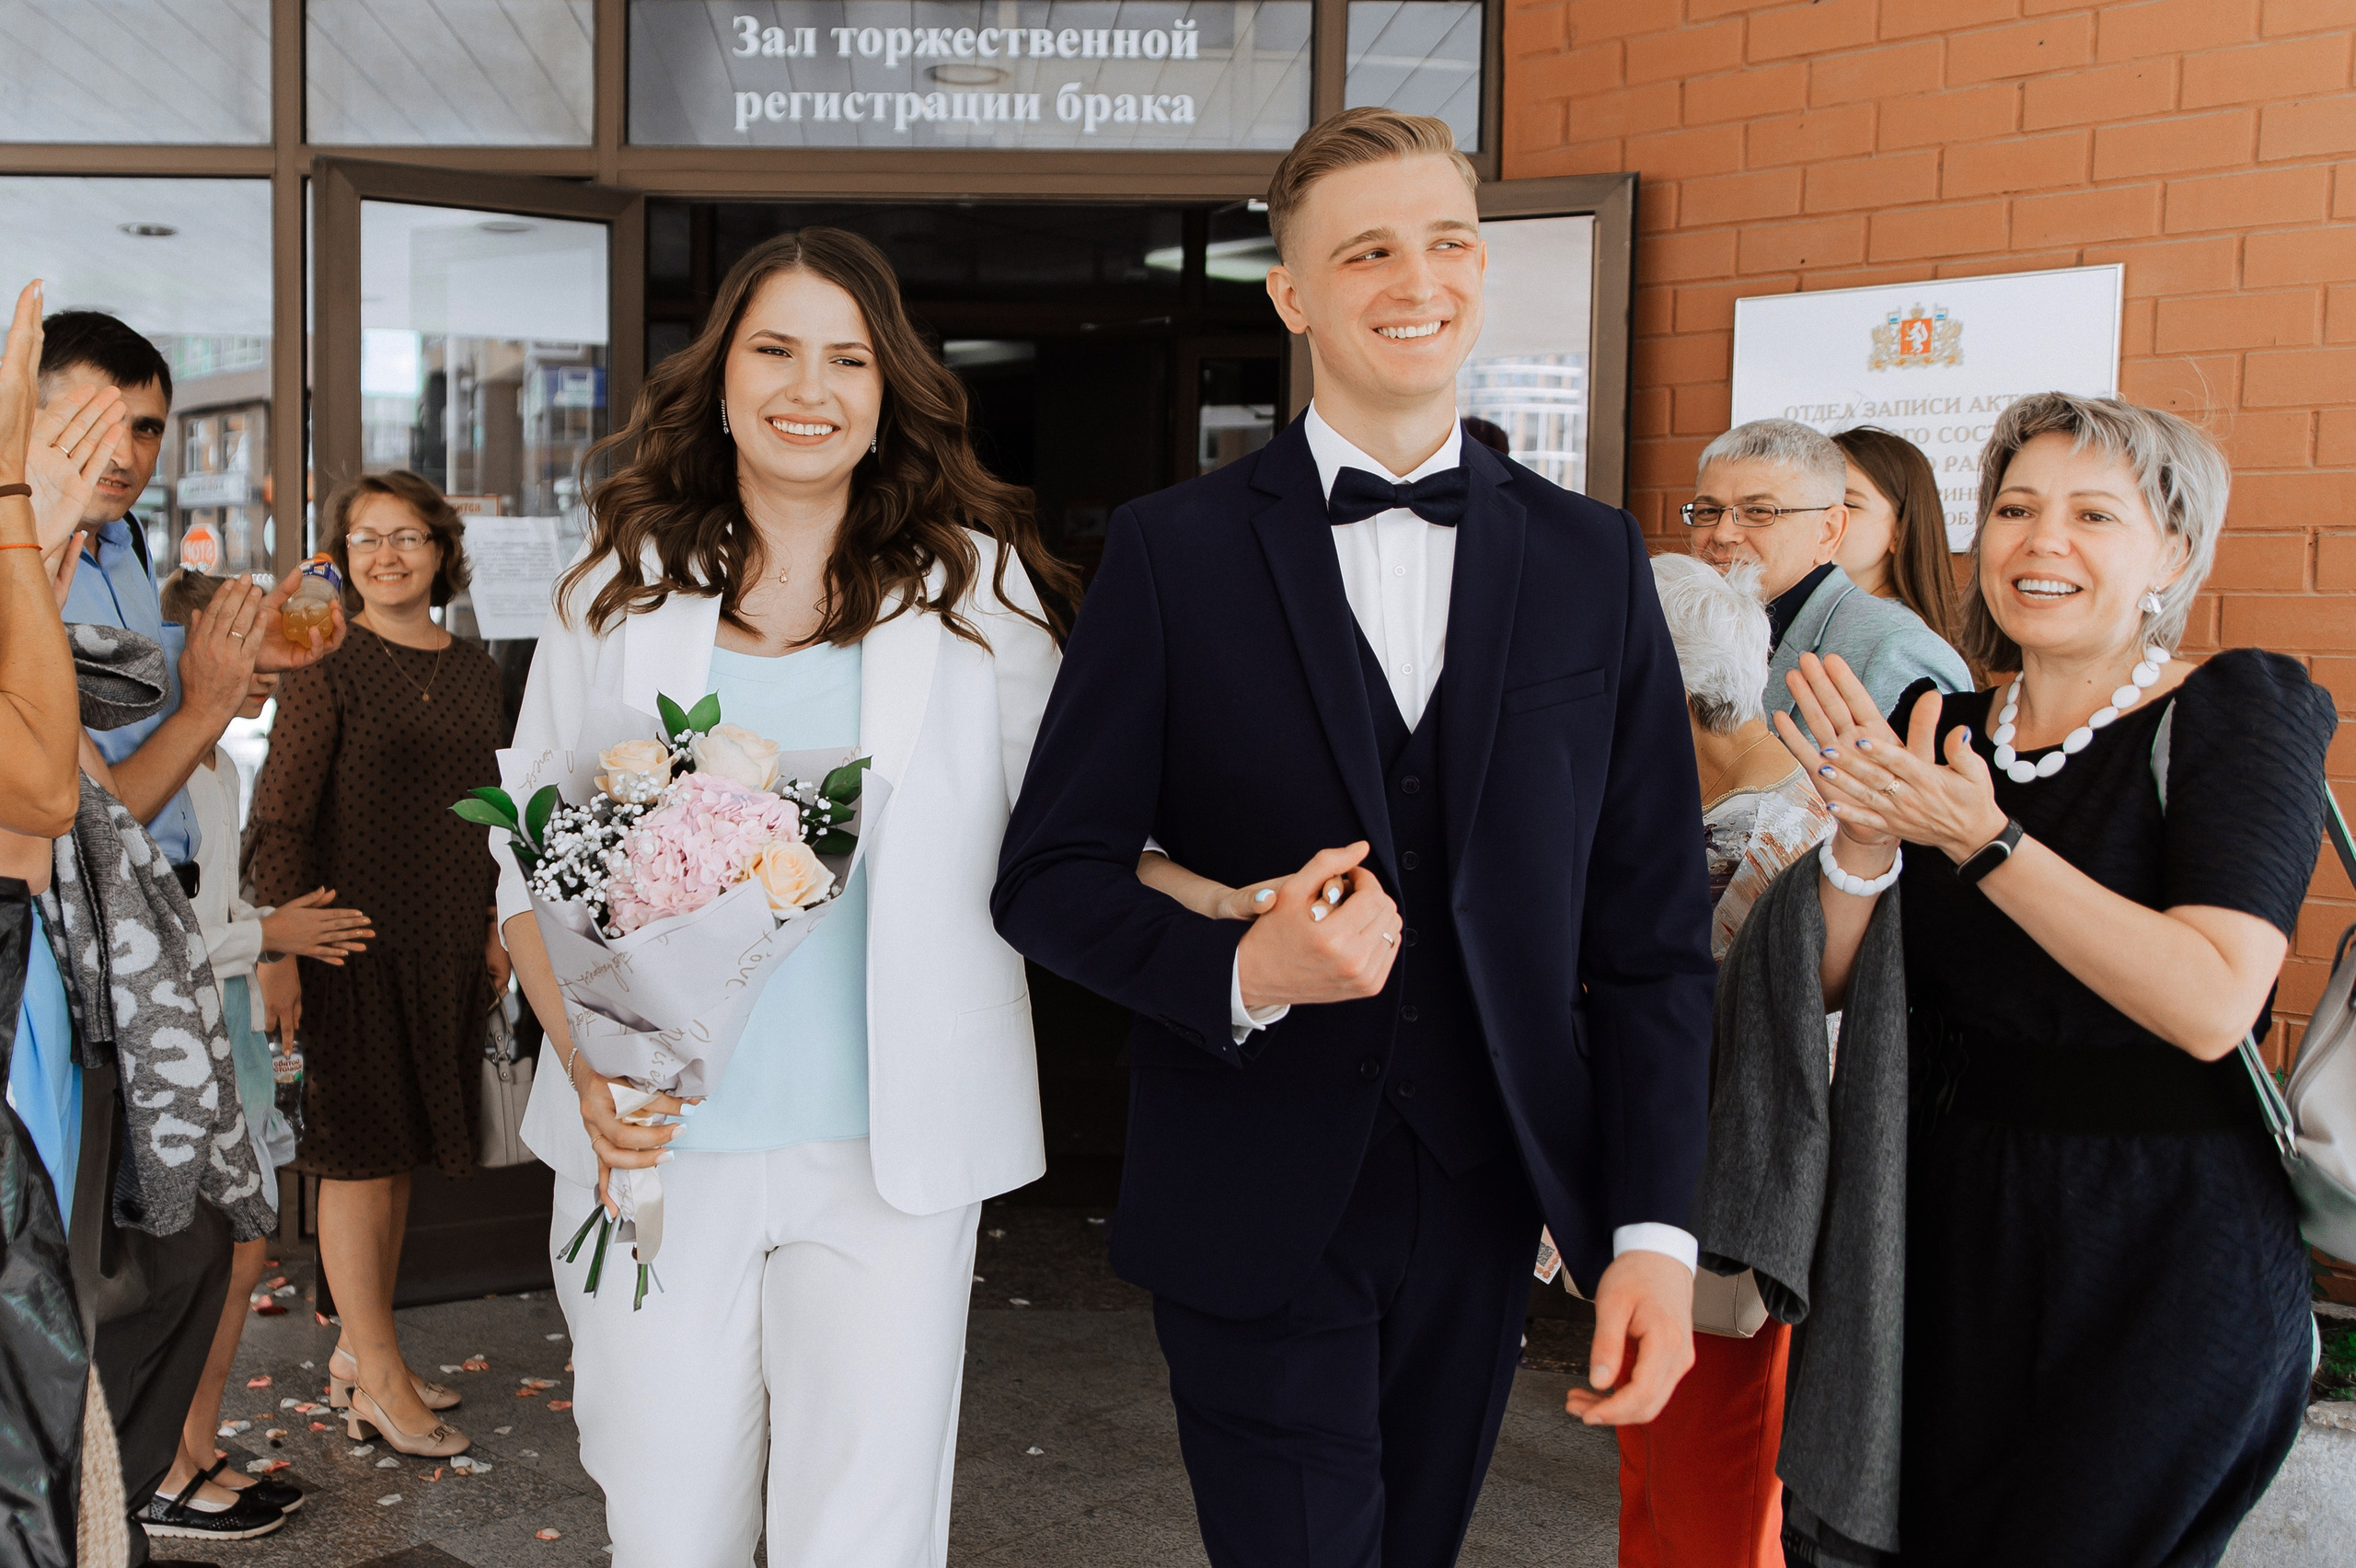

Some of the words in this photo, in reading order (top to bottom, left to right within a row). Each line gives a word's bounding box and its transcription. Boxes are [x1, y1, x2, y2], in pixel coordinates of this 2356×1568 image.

[732, 14, 817, 57] Зал
[830, 18, 1199, 68] торжественной
[733, 87, 1041, 133] регистрации
[1056, 82, 1195, 133] брака
[1784, 402, 1855, 423] ОТДЕЛ
[1862, 397, 1961, 419] ЗАПИСИ
